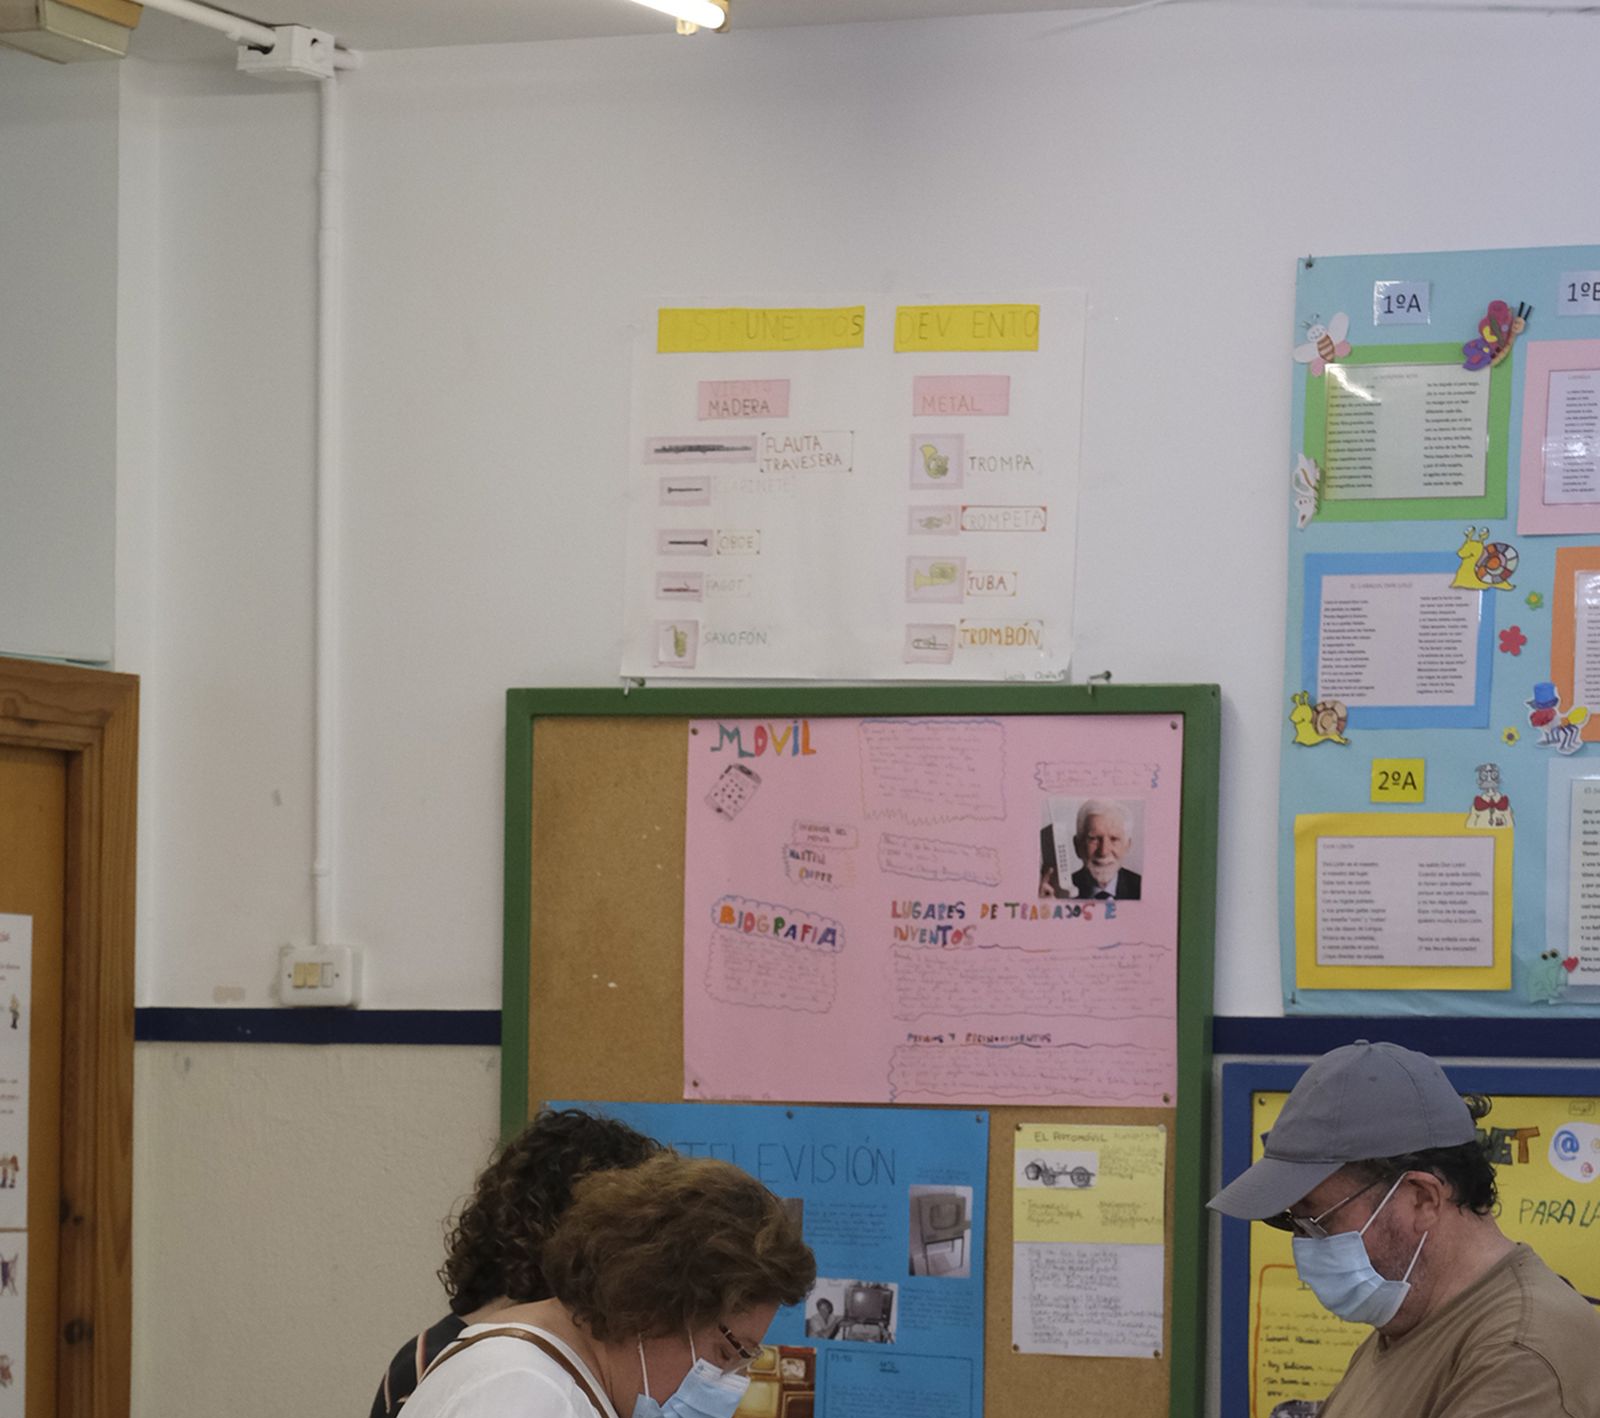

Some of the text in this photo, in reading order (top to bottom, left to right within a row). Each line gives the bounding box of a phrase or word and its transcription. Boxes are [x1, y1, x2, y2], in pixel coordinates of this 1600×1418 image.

[1383, 293, 1422, 315] 1ºA
[708, 397, 771, 417] MADERA
[921, 395, 983, 414] METAL
[763, 453, 843, 471] TRAVESERA
[969, 454, 1034, 472] TROMPA
[968, 574, 1008, 591] TUBA
[961, 621, 1040, 647] TROMBÓN
[1378, 770, 1417, 791] 2ºA
[891, 899, 966, 921] LUGARES
[979, 903, 999, 920] DE
[1104, 900, 1117, 920] E
[719, 904, 838, 947] BIOGRAFIA
[1518, 1198, 1576, 1226] PARA
